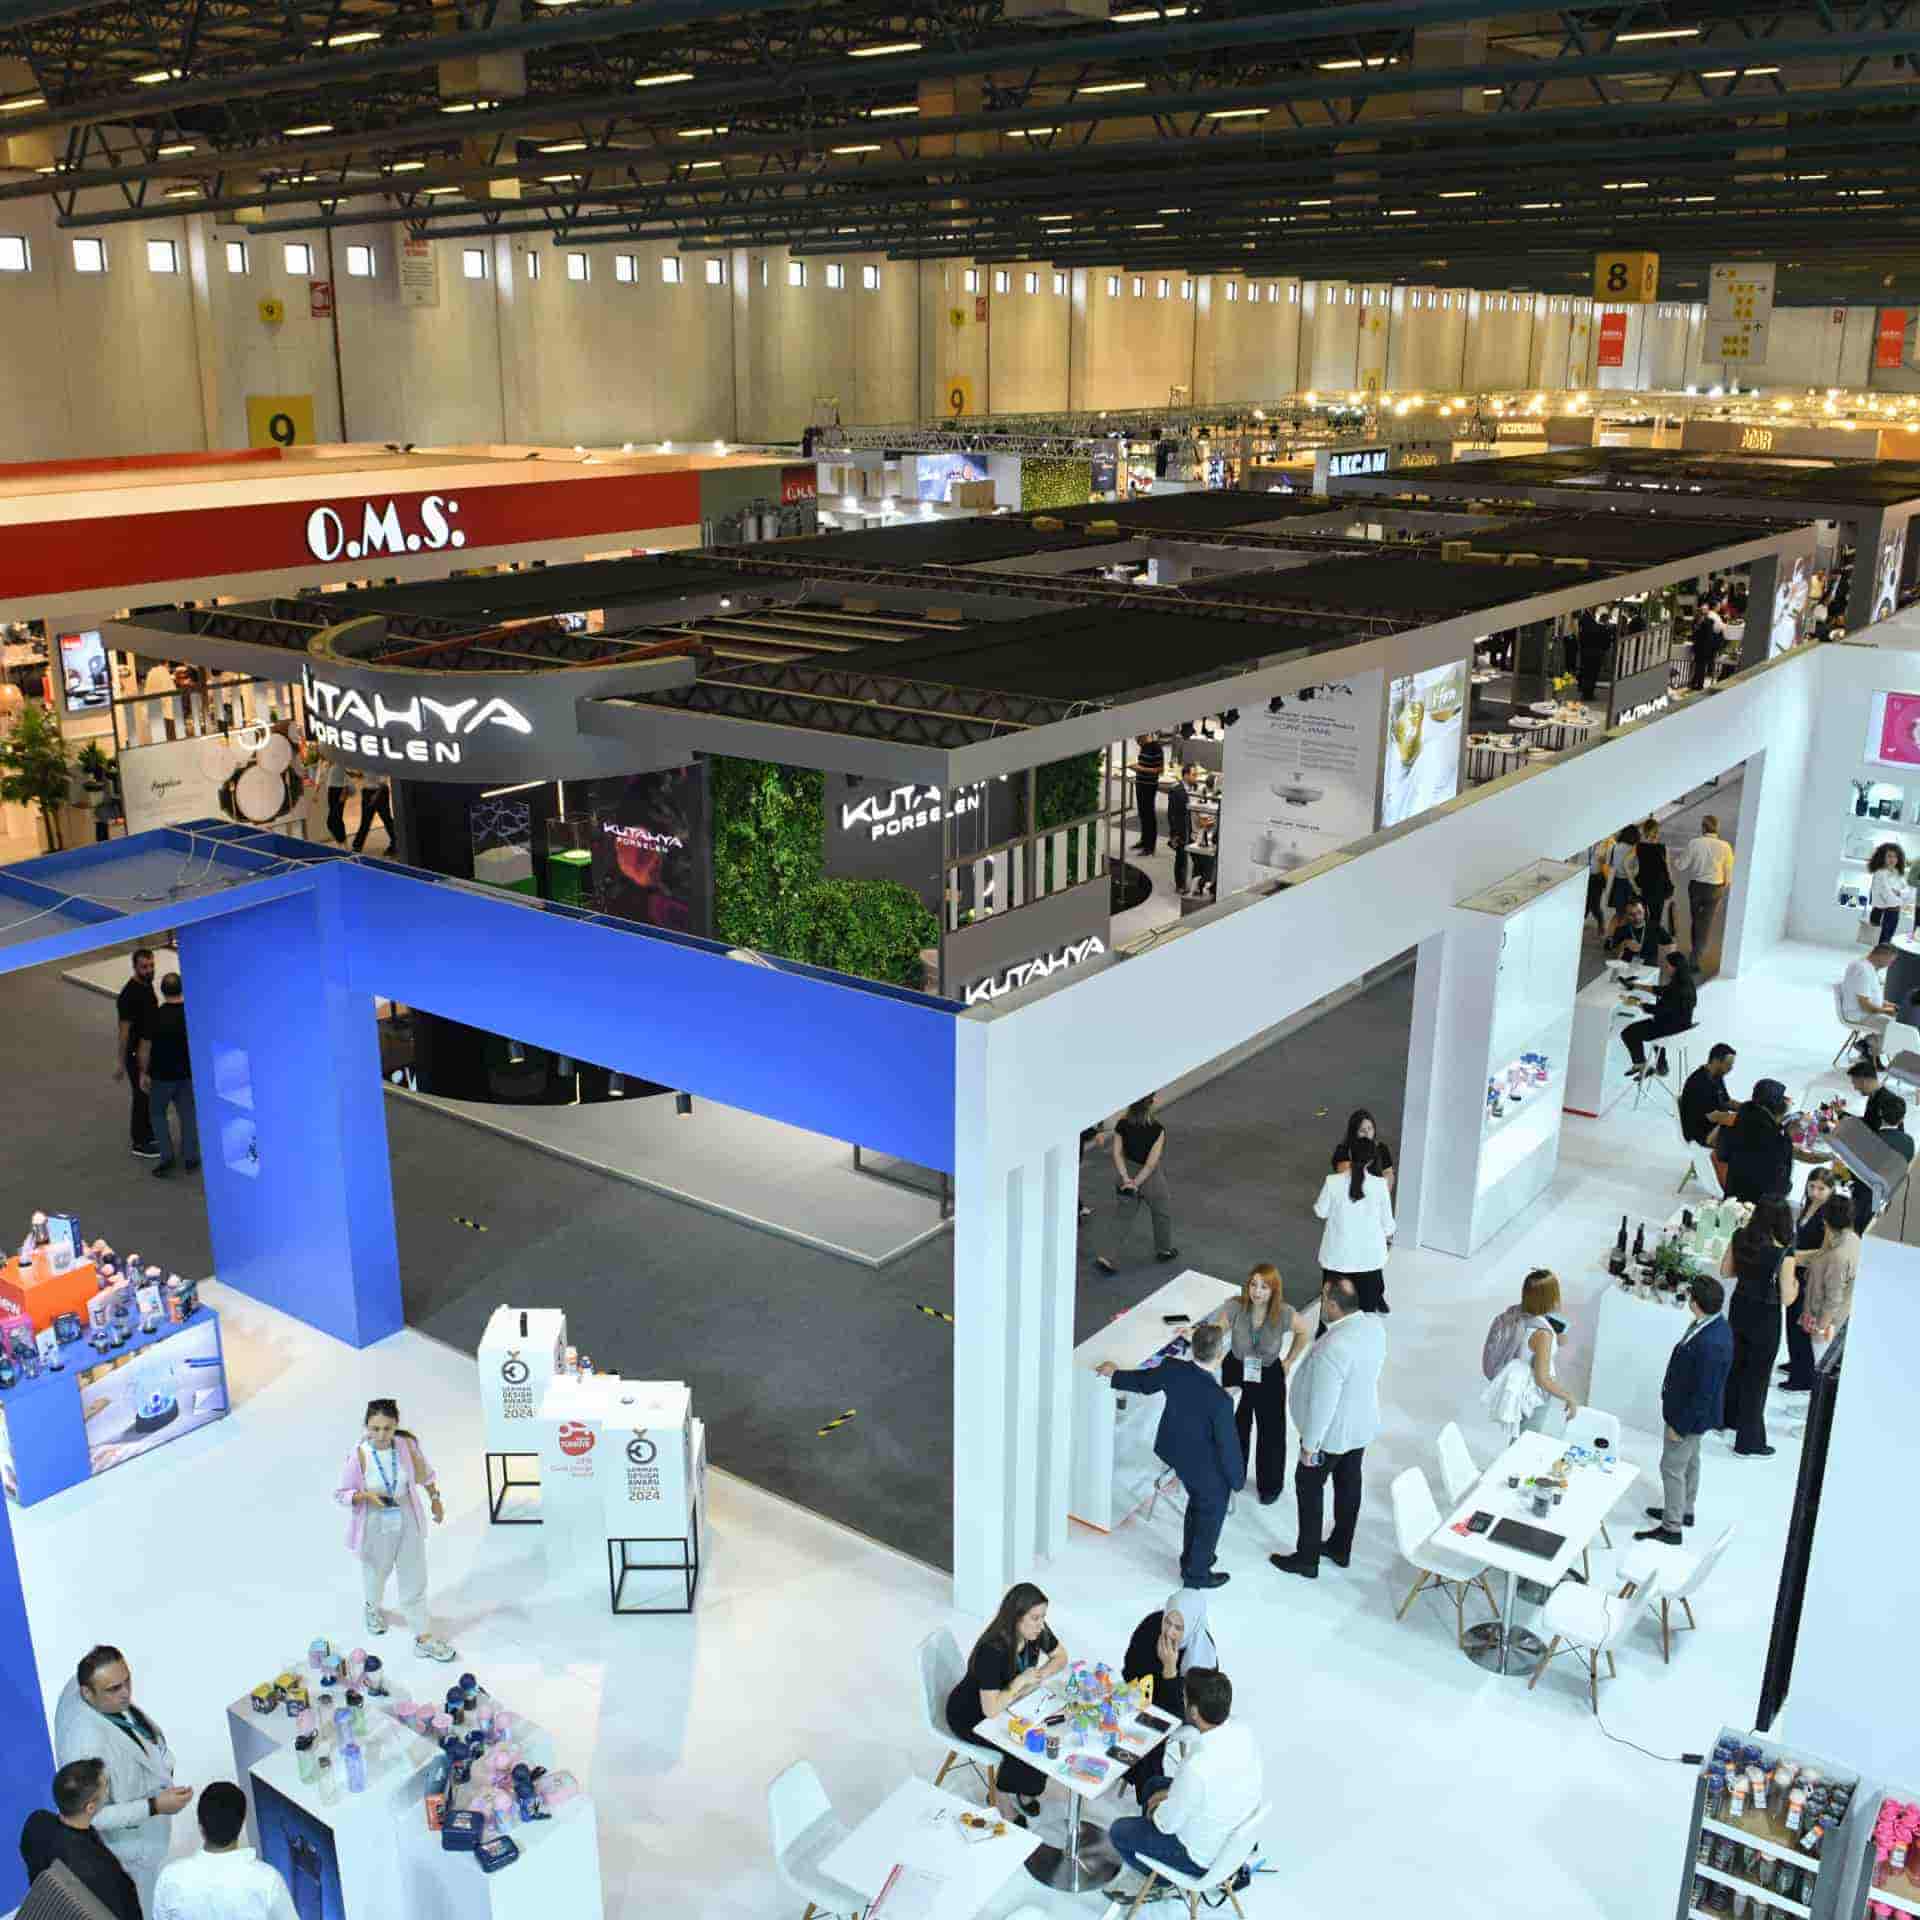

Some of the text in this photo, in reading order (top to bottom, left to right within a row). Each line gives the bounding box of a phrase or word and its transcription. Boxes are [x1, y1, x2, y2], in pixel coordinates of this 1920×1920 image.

[1607, 263, 1627, 291] 8
[951, 389, 965, 417] 9
[269, 412, 295, 446] 9
[603, 822, 683, 849] KUTAHYA
[965, 935, 1105, 1006] KUTAHYA
[503, 1407, 534, 1418] 2024
[628, 1490, 661, 1501] 2024
